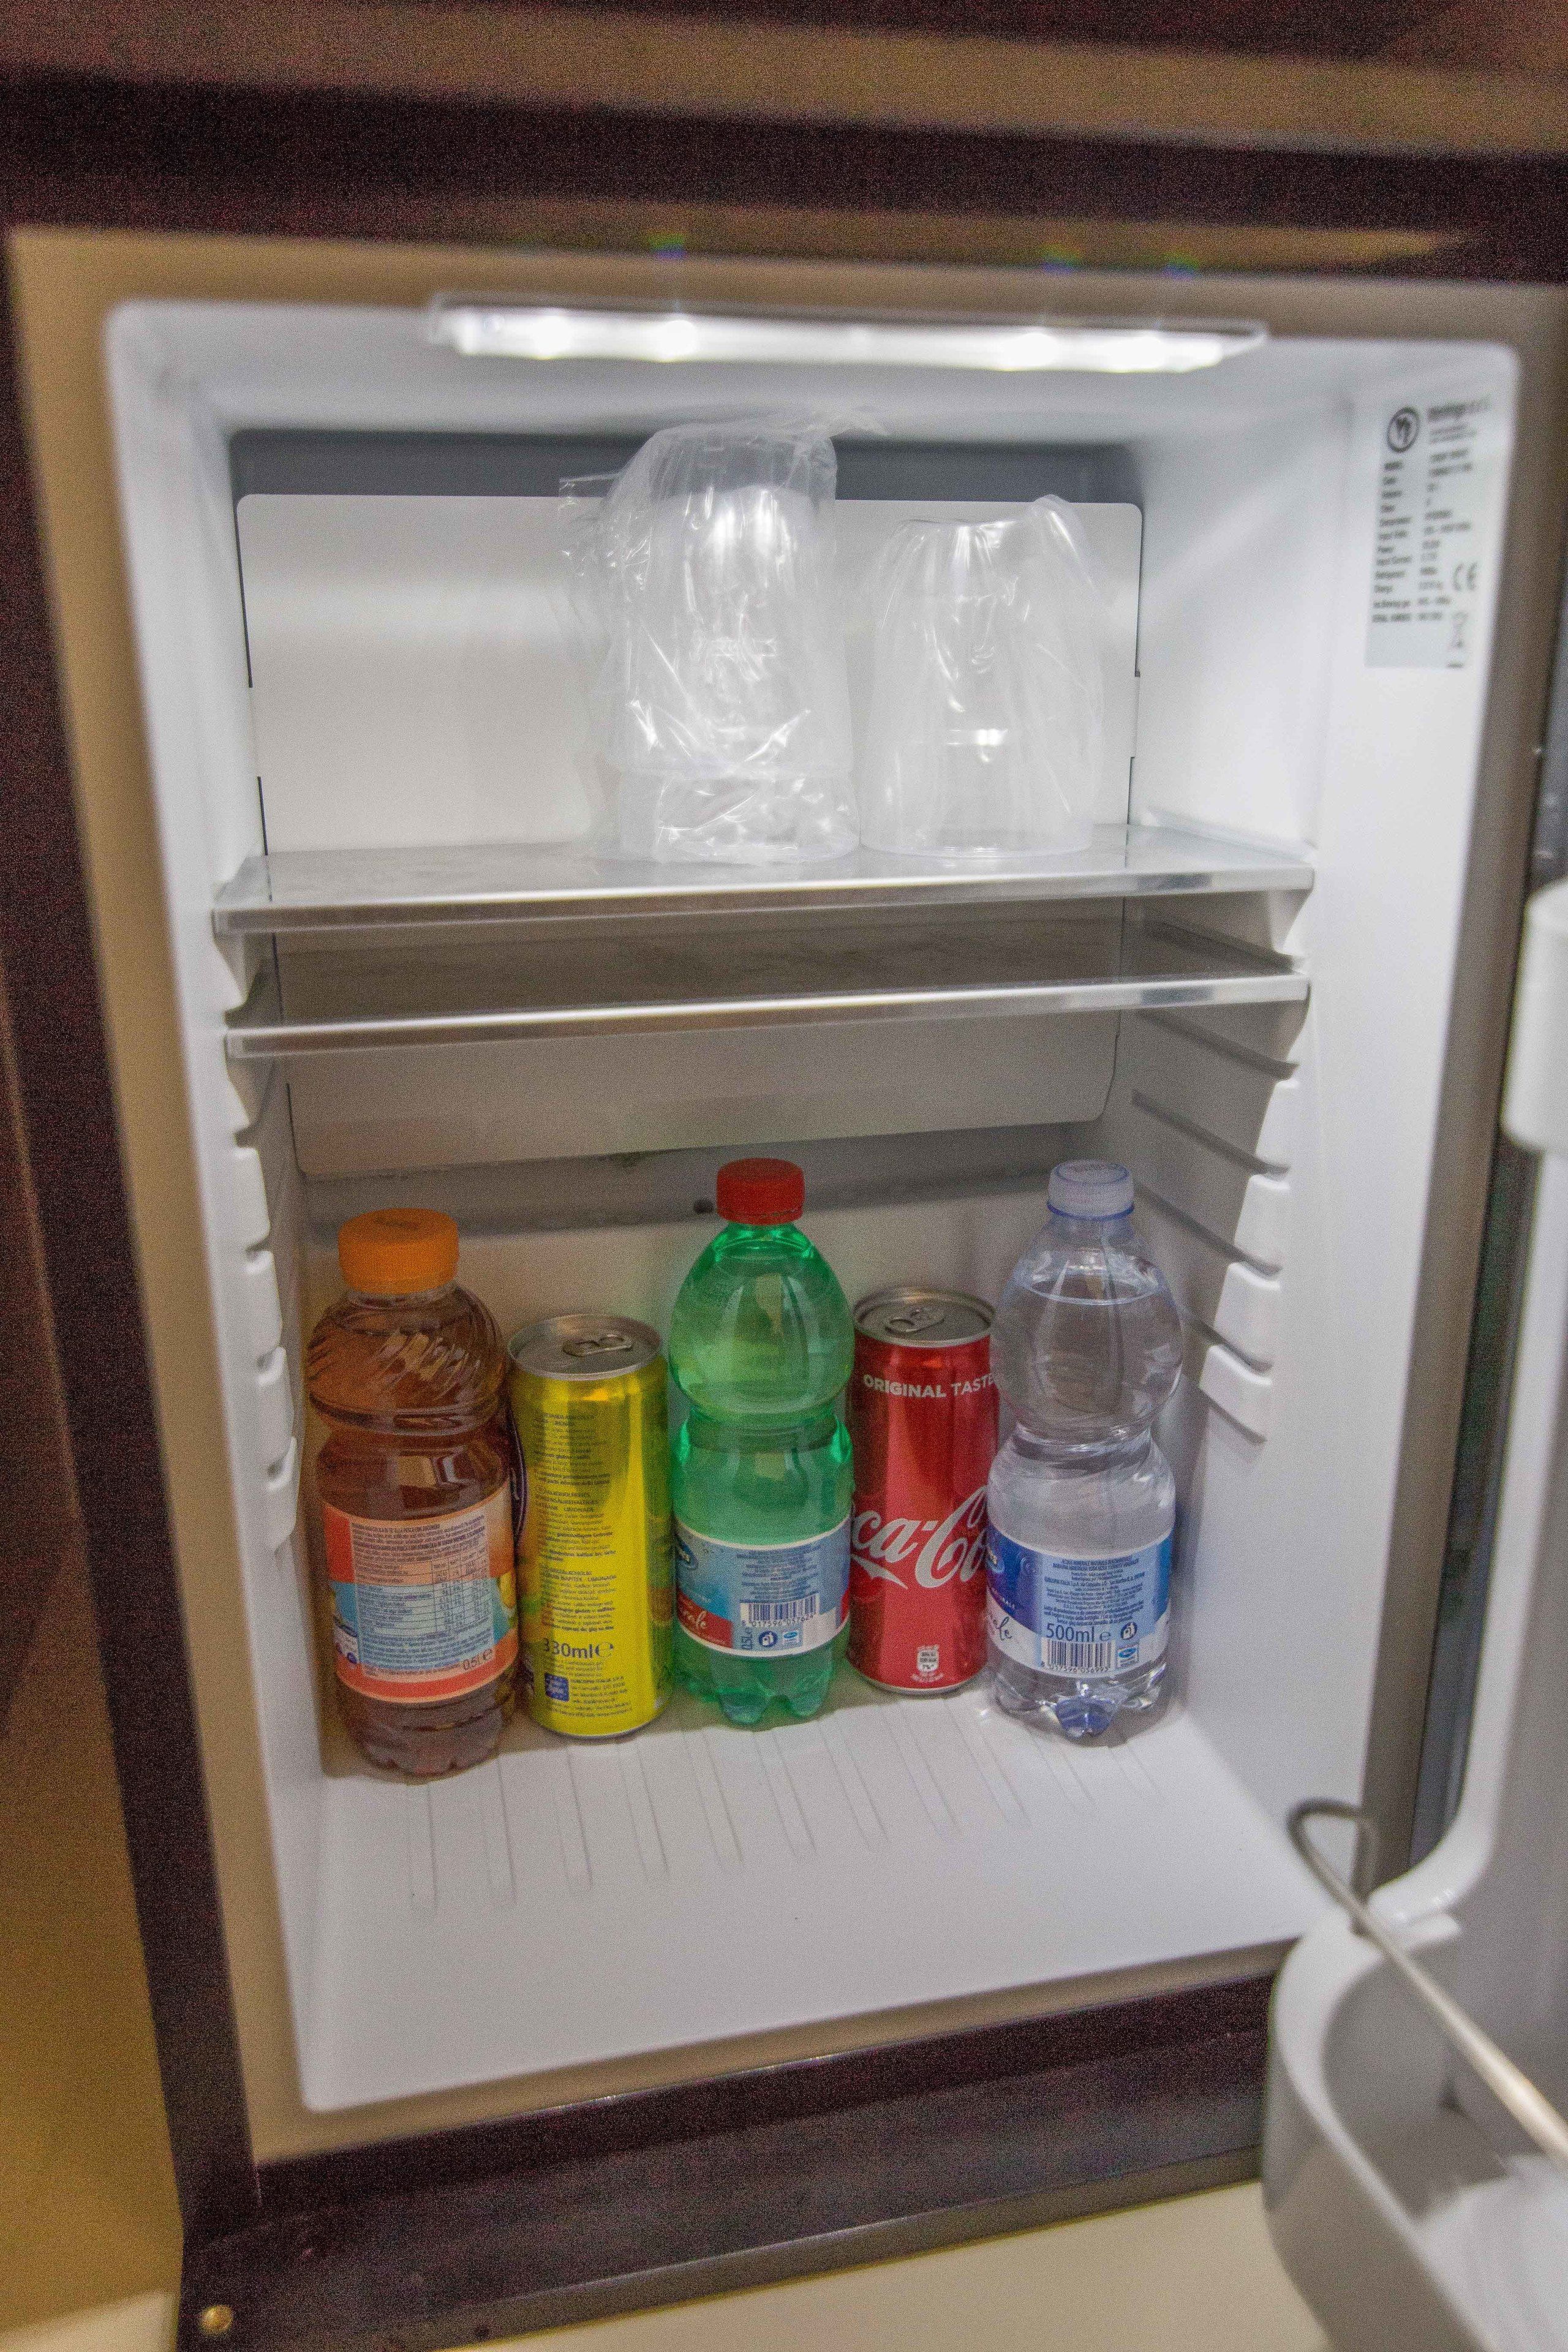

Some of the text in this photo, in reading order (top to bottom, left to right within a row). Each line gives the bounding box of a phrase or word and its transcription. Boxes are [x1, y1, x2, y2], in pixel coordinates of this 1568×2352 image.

[863, 1373, 947, 1398] ORIGINAL
[1046, 1623, 1095, 1643] 500ml
[543, 1637, 593, 1659] 330ml
